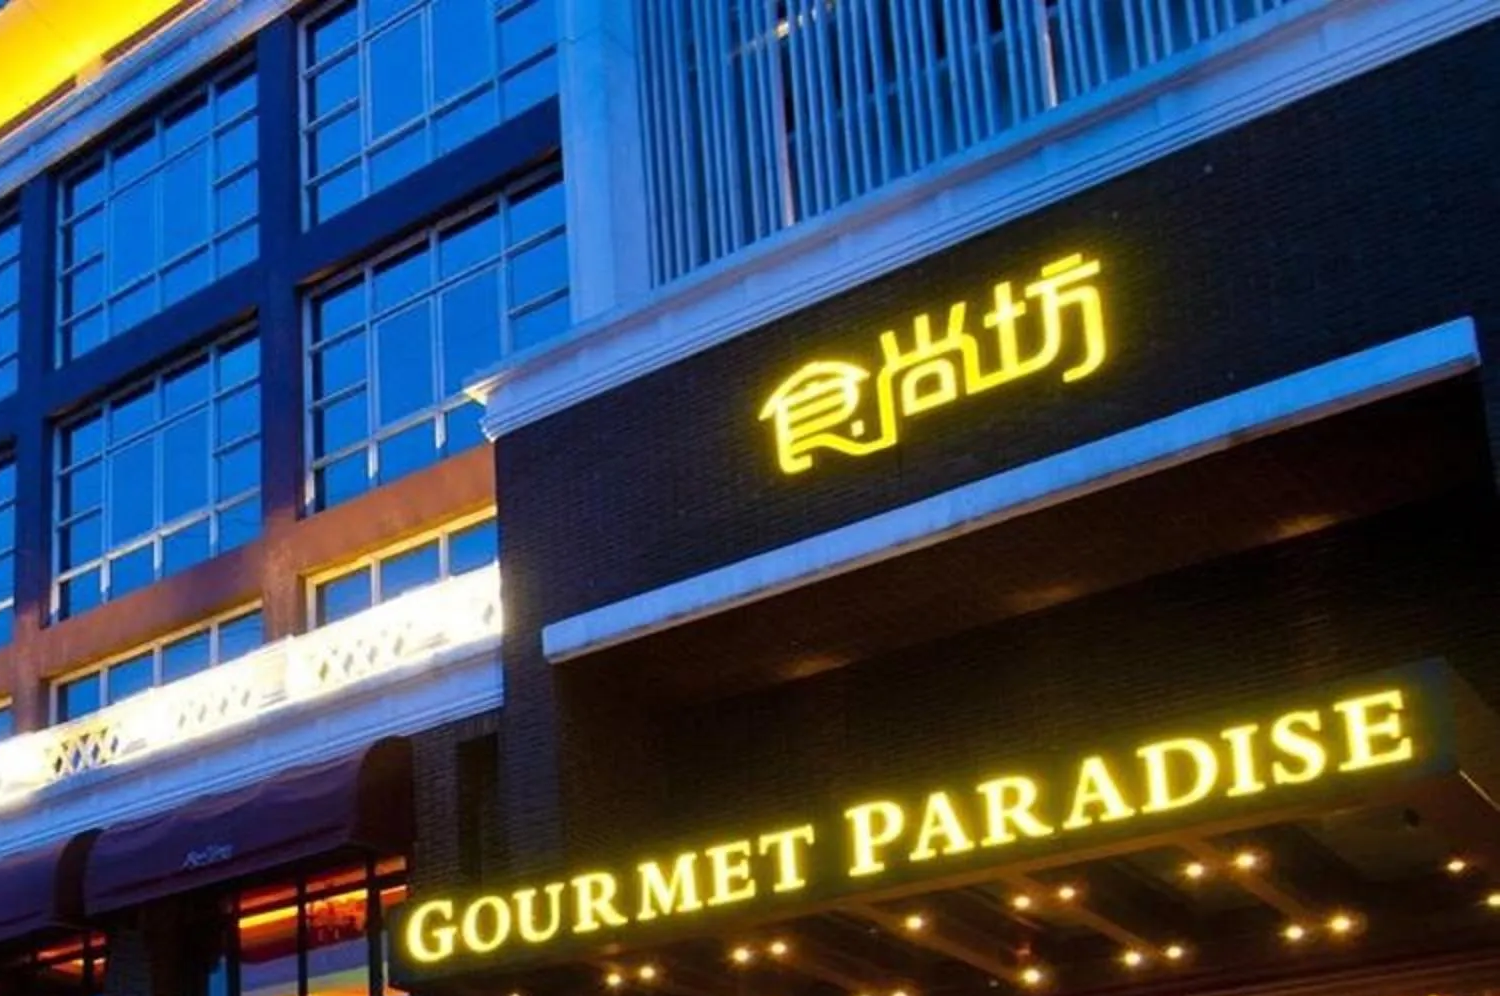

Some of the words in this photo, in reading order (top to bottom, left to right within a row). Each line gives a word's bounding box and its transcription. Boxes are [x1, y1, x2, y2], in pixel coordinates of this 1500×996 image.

[758, 253, 1106, 474] 食尚坊
[406, 824, 815, 962] GOURMET
[844, 690, 1413, 877] PARADISE
